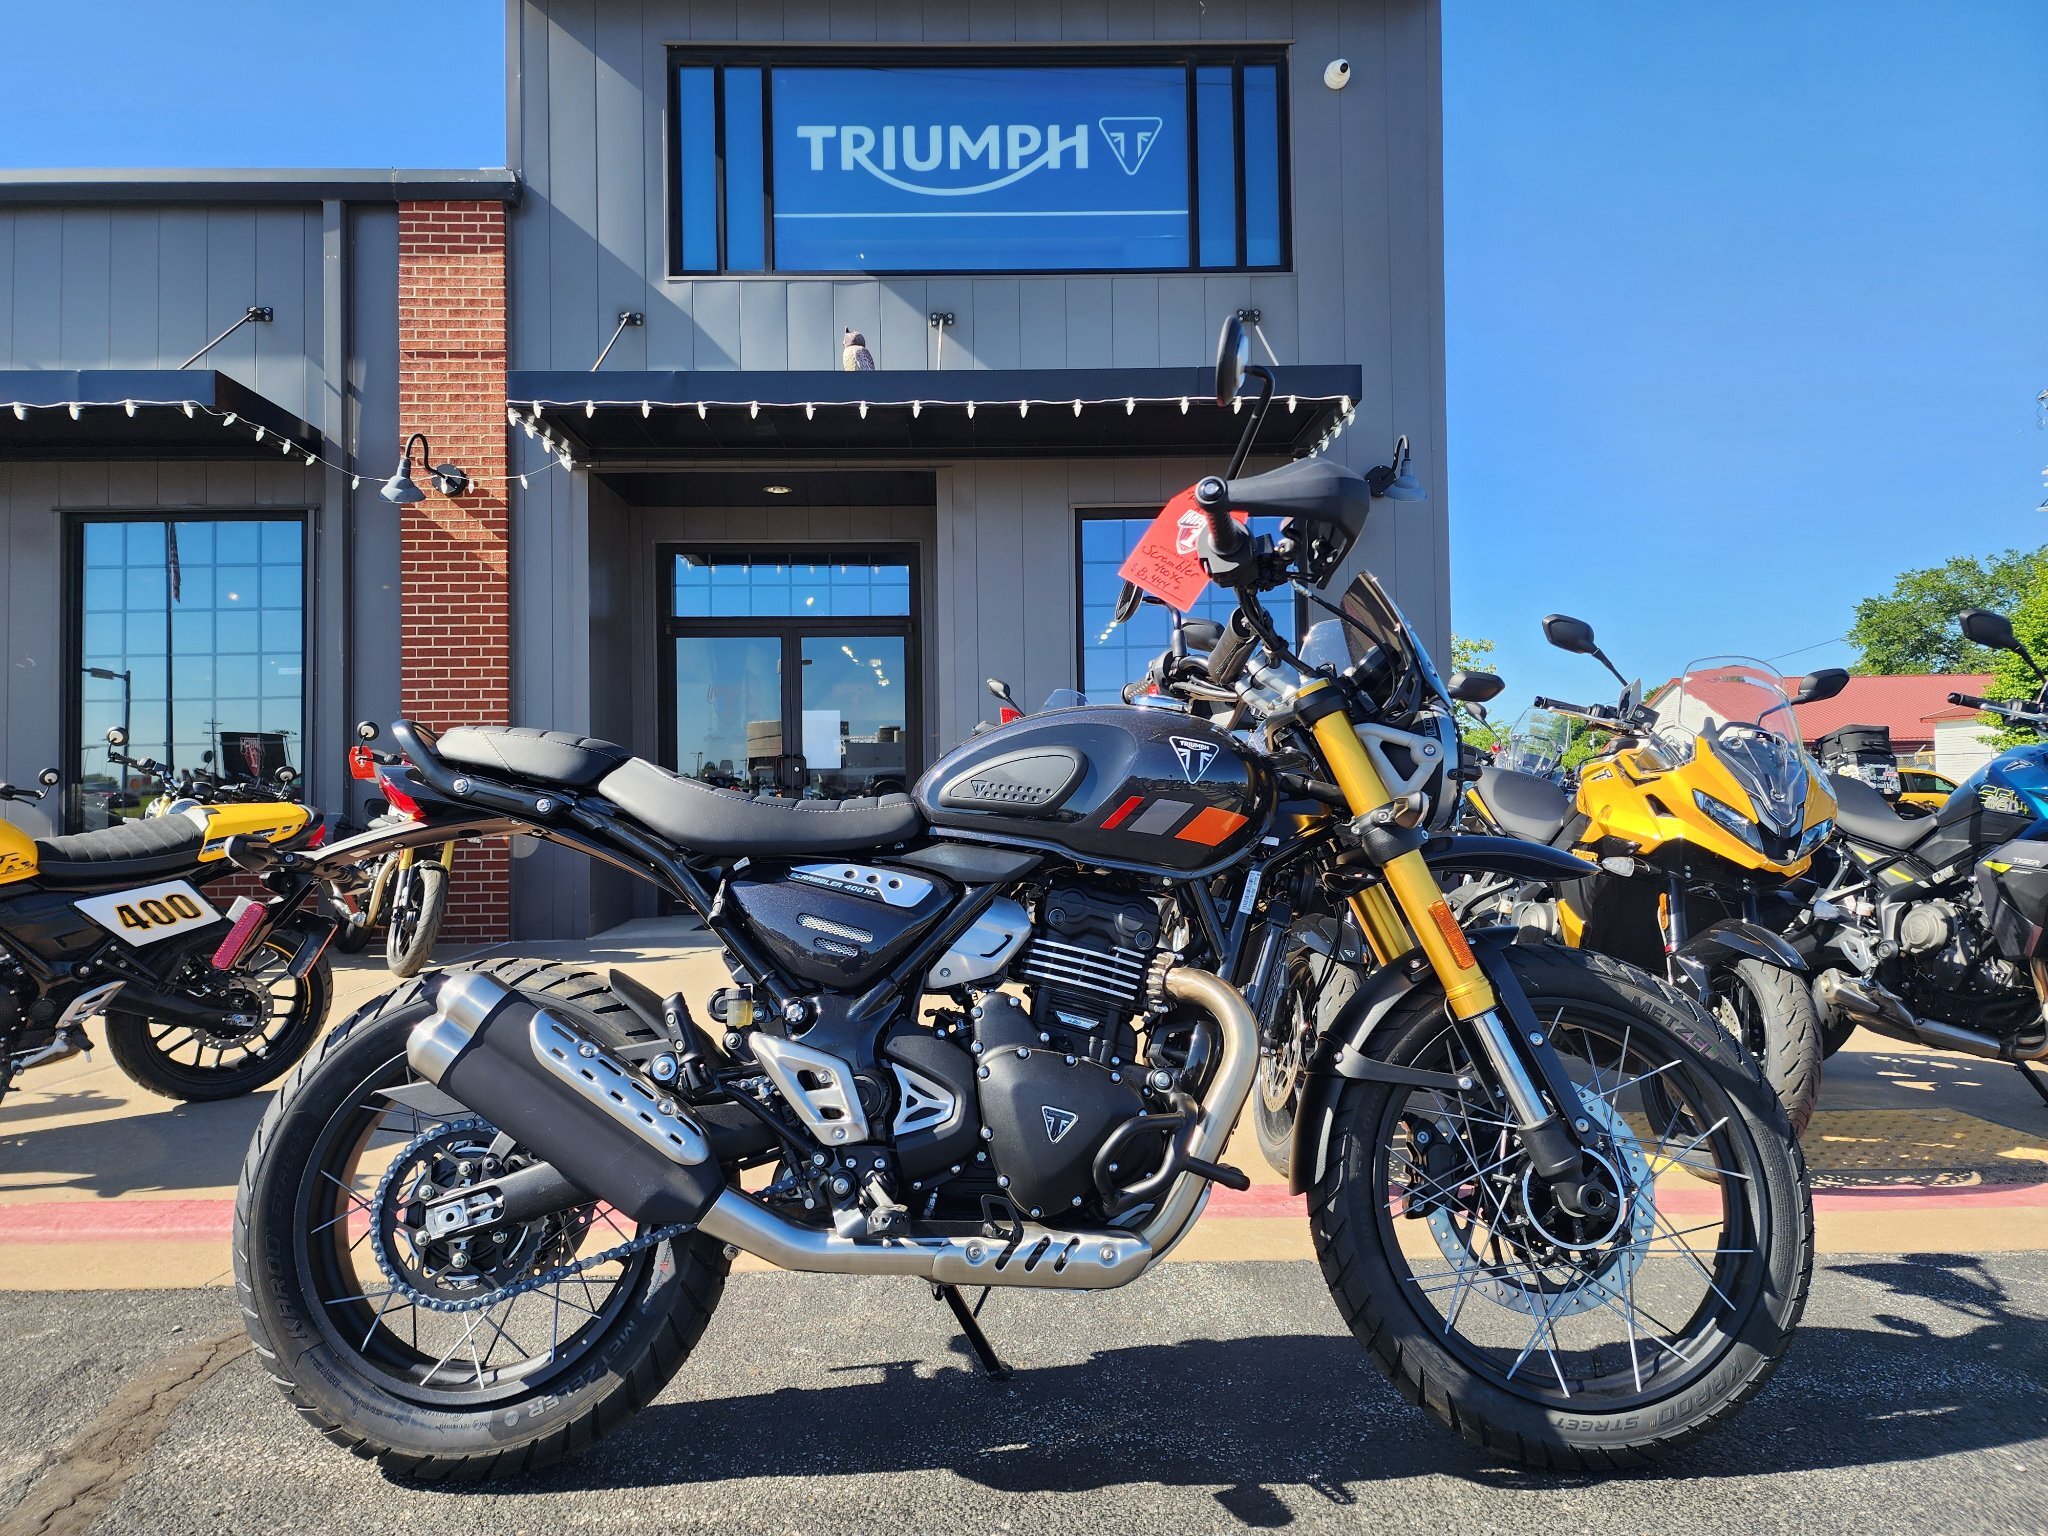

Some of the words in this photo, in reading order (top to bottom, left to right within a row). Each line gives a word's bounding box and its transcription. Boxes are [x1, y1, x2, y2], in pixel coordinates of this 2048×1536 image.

[797, 125, 1088, 196] TRIUMPH
[1142, 544, 1200, 578] Scrambler
[1180, 741, 1210, 751] TRIUMPH
[1571, 849, 1599, 862] TIGER
[789, 873, 843, 888] SCRAMBLER
[844, 884, 864, 893] 400
[864, 888, 878, 896] XC
[114, 893, 203, 931] 400
[1631, 995, 1726, 1064] METZEL
[265, 1233, 308, 1340] KAROO
[527, 1319, 639, 1419] METZELER
[1654, 1353, 1743, 1427] KAROO
[1551, 1415, 1640, 1433] STREET
